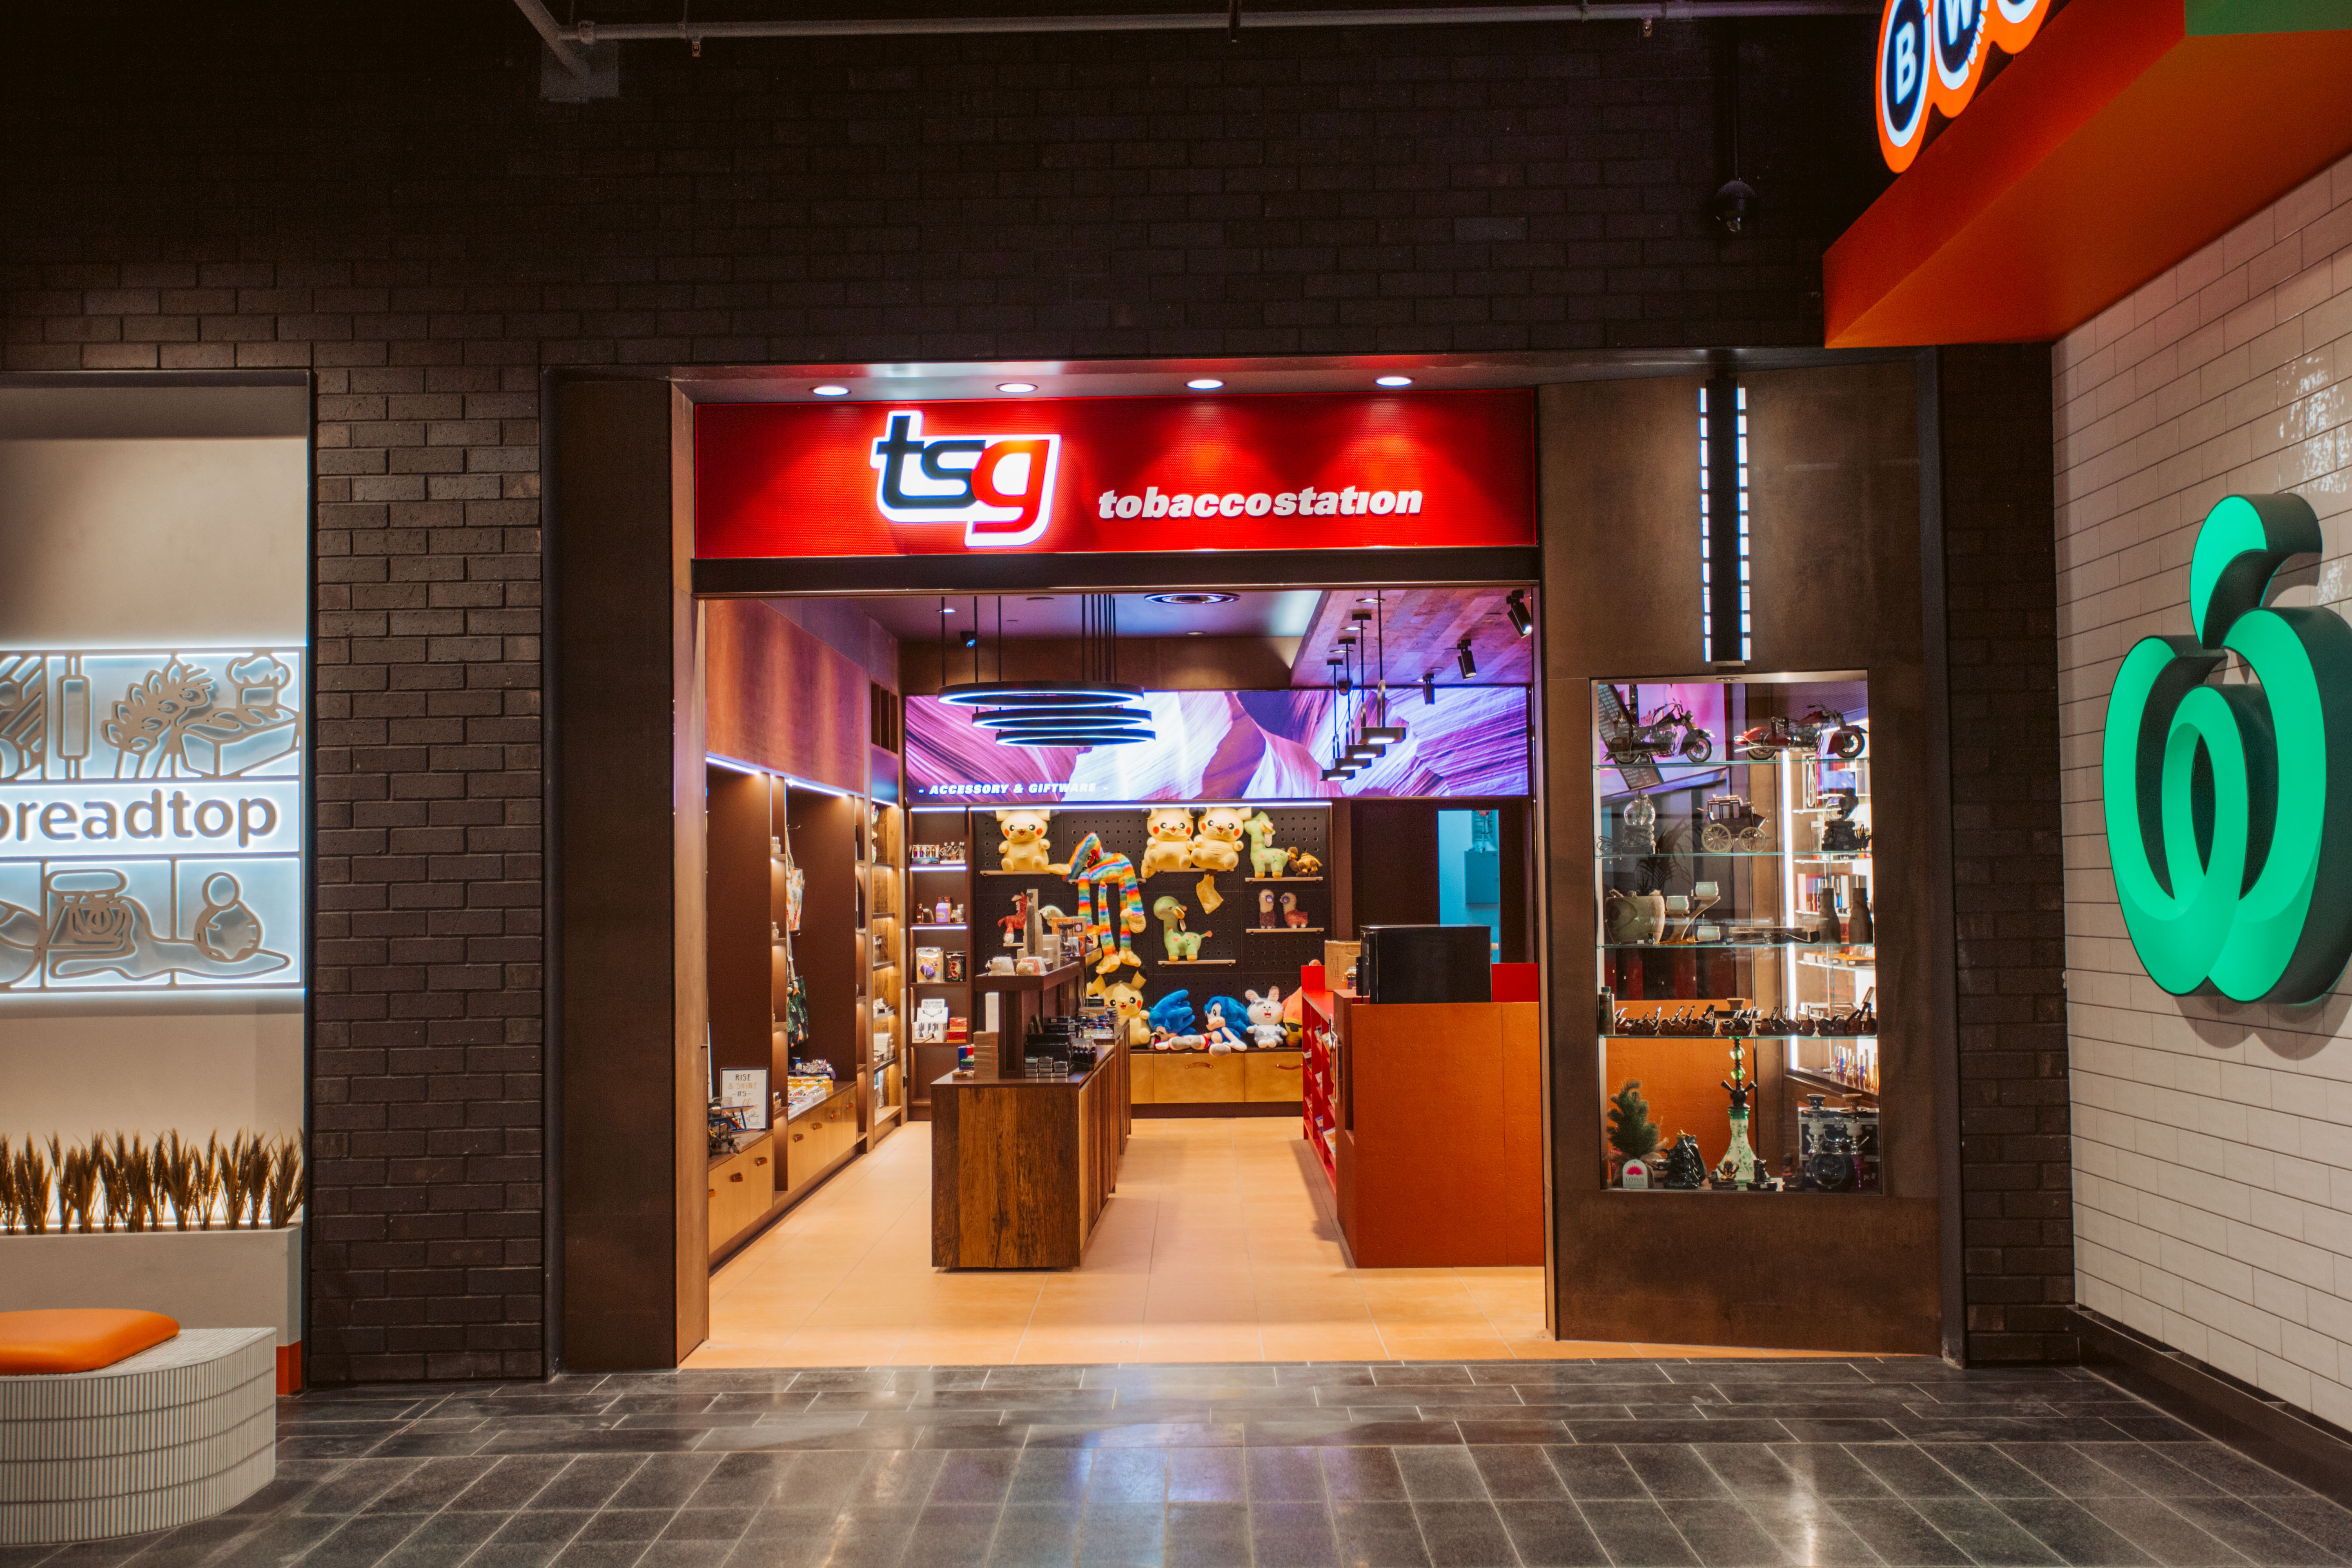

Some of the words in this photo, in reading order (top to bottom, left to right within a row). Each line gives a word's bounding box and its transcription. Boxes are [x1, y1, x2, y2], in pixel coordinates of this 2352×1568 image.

[874, 413, 1052, 534] tsg
[1099, 486, 1423, 519] tobaccostation
[929, 784, 1009, 795] ACCESSORY
[1013, 783, 1023, 793] &
[1028, 783, 1096, 793] GIFTWARE
[0, 788, 277, 848] readtop
